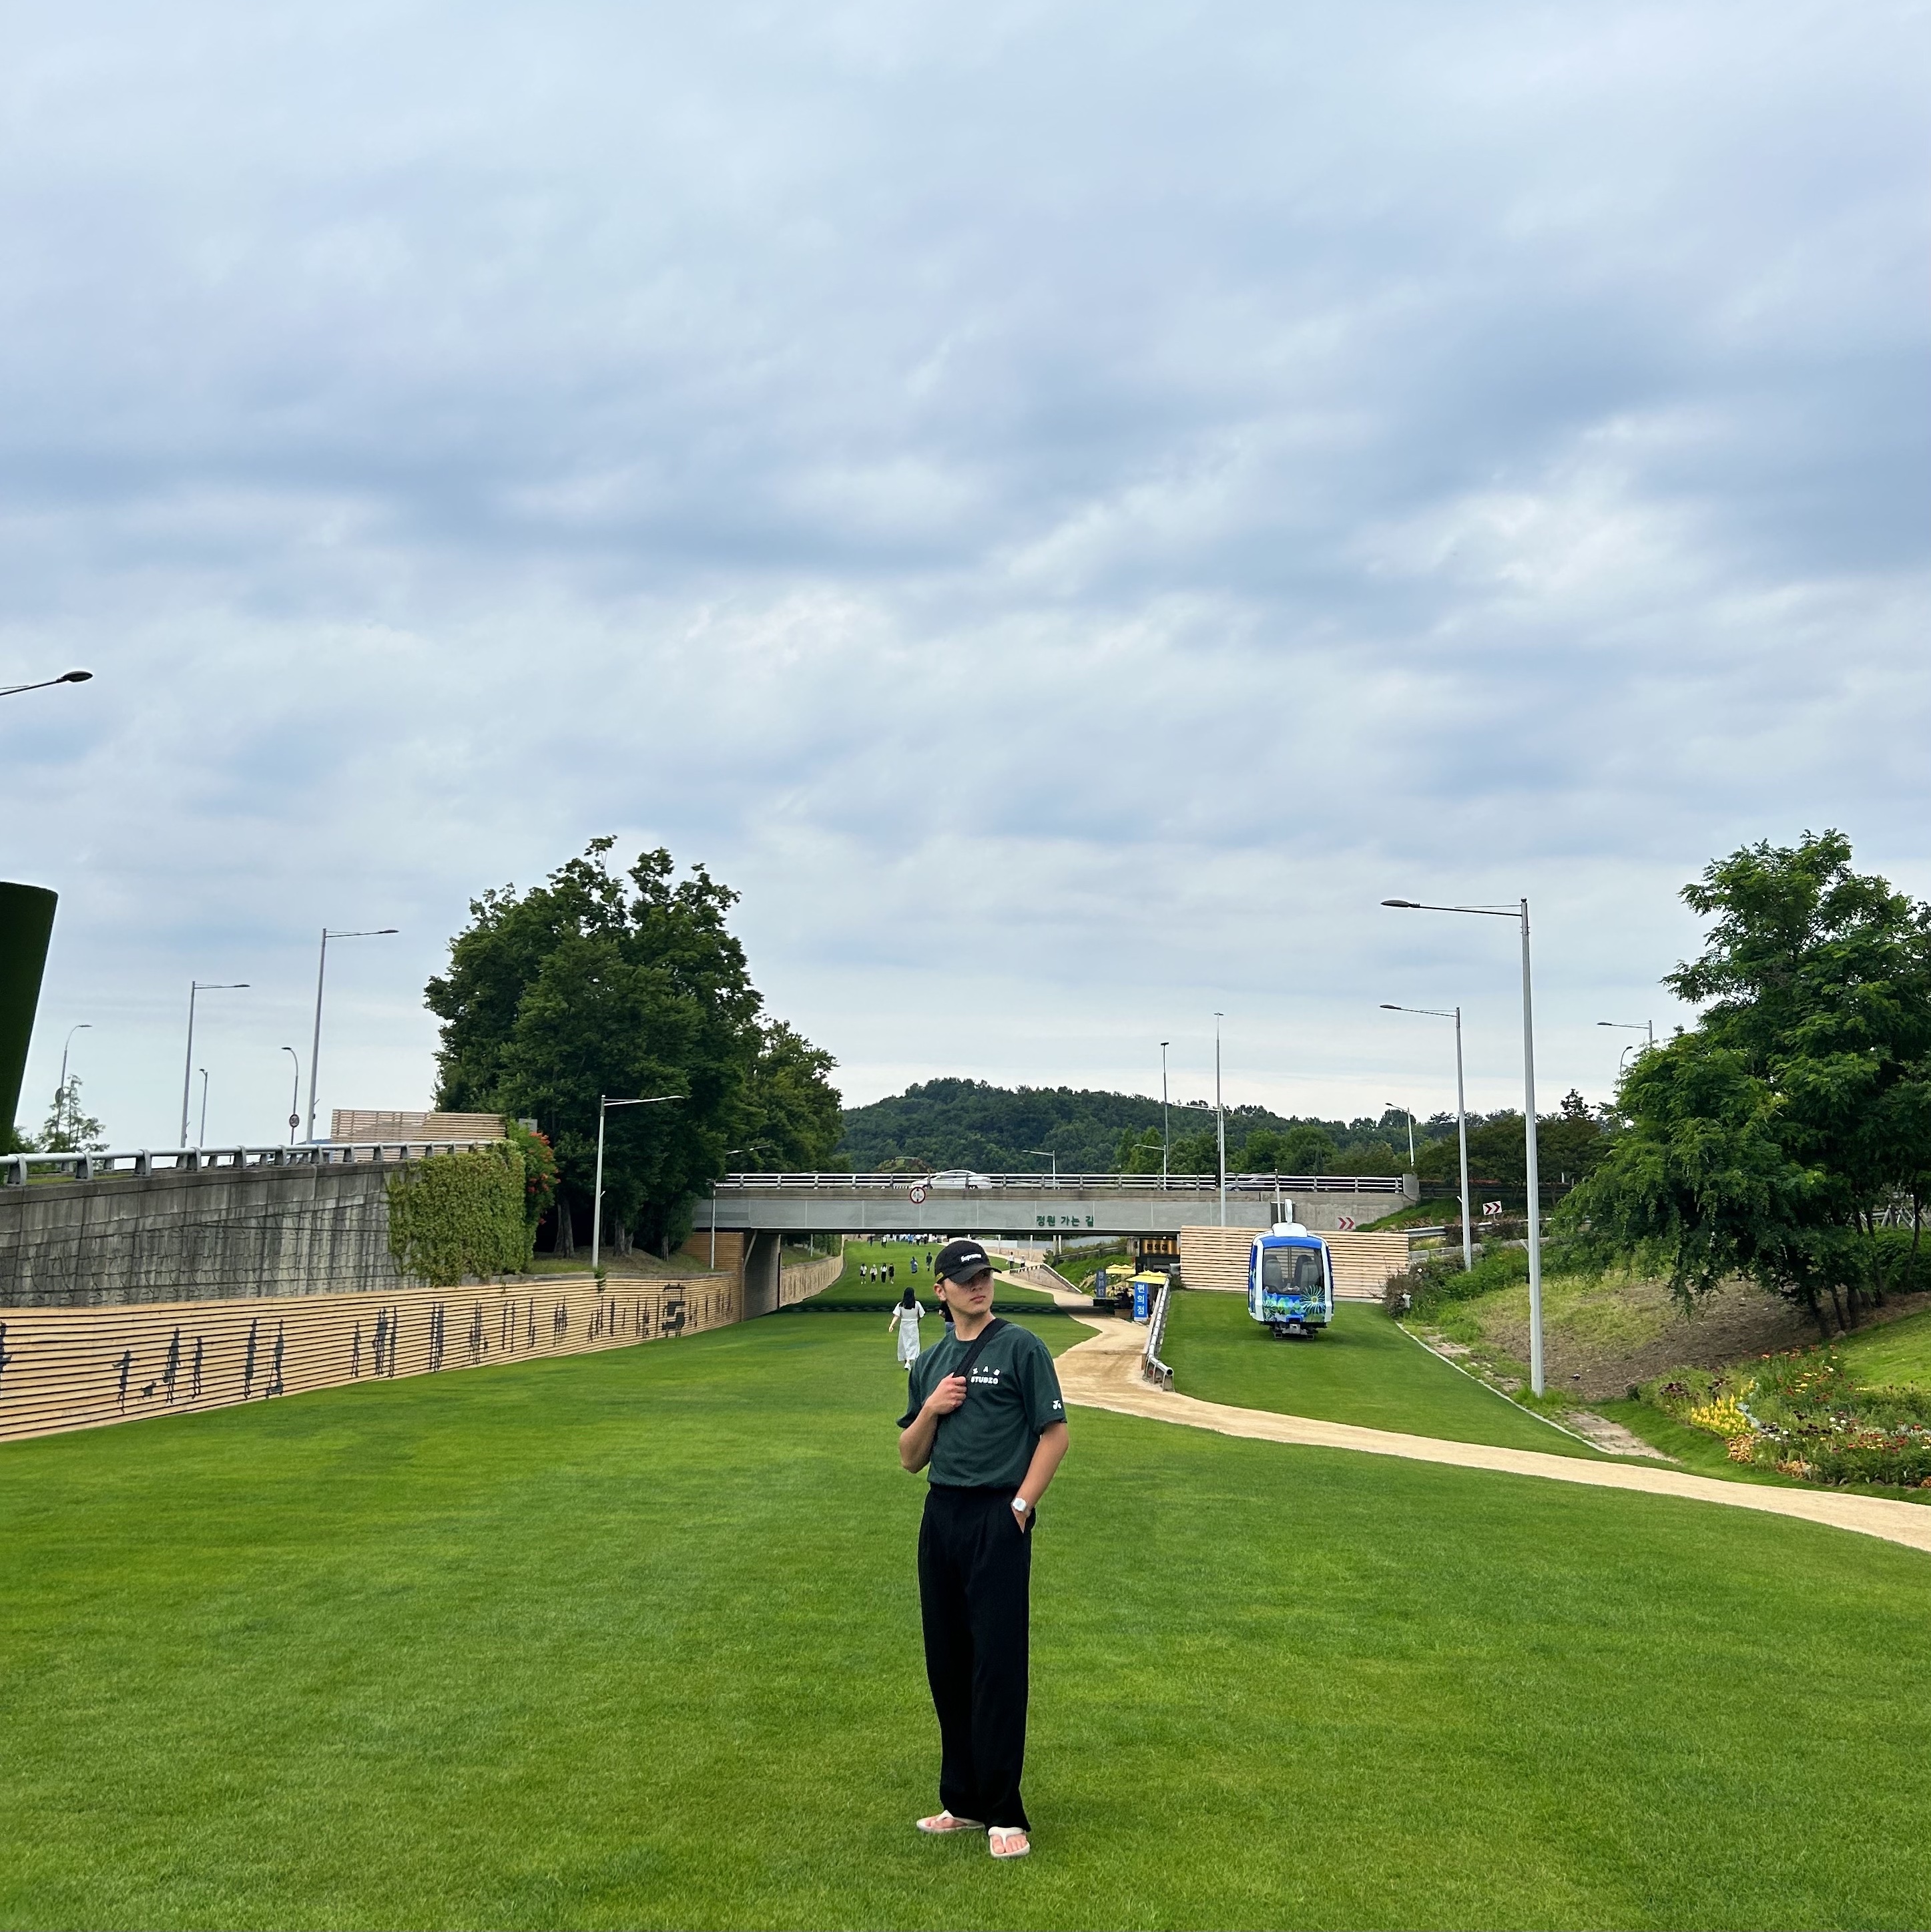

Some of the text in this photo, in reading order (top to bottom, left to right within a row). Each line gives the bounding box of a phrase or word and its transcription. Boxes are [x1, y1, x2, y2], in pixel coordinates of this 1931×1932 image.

[1036, 1214, 1094, 1227] 정원 가는 길
[1137, 1284, 1145, 1315] 편의점
[971, 1376, 999, 1385] STUDIO
